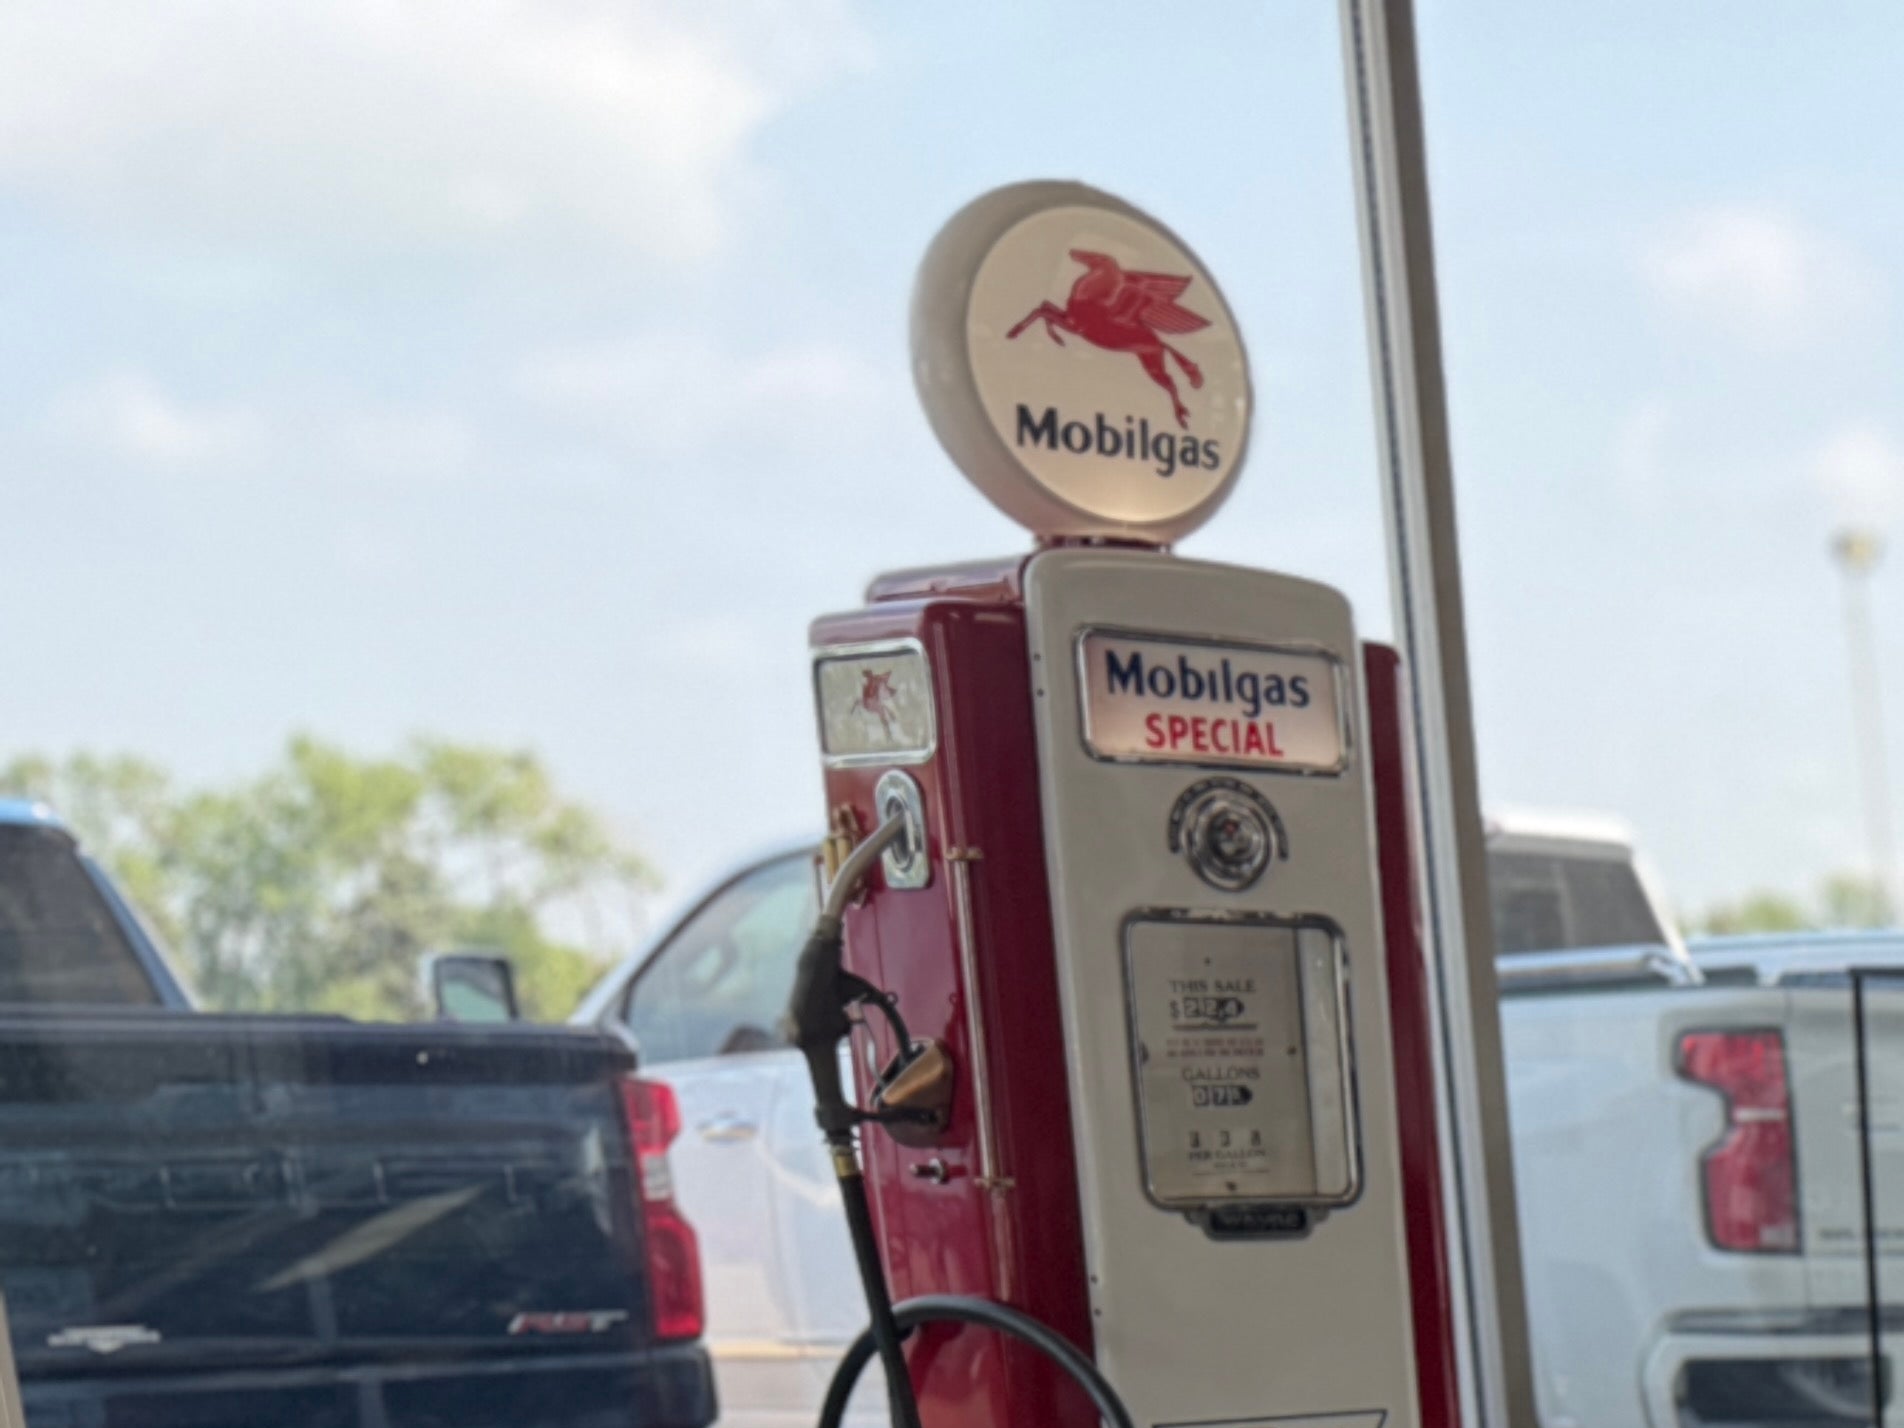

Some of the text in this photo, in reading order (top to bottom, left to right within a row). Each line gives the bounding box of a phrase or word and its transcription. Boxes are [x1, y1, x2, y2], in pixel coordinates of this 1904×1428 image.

[1015, 404, 1220, 476] Mobilgas
[1106, 650, 1310, 717] Mobilgas
[1145, 713, 1284, 758] SPECIAL
[1169, 979, 1257, 994] THIS SALE
[1182, 1066, 1261, 1081] GALLONS
